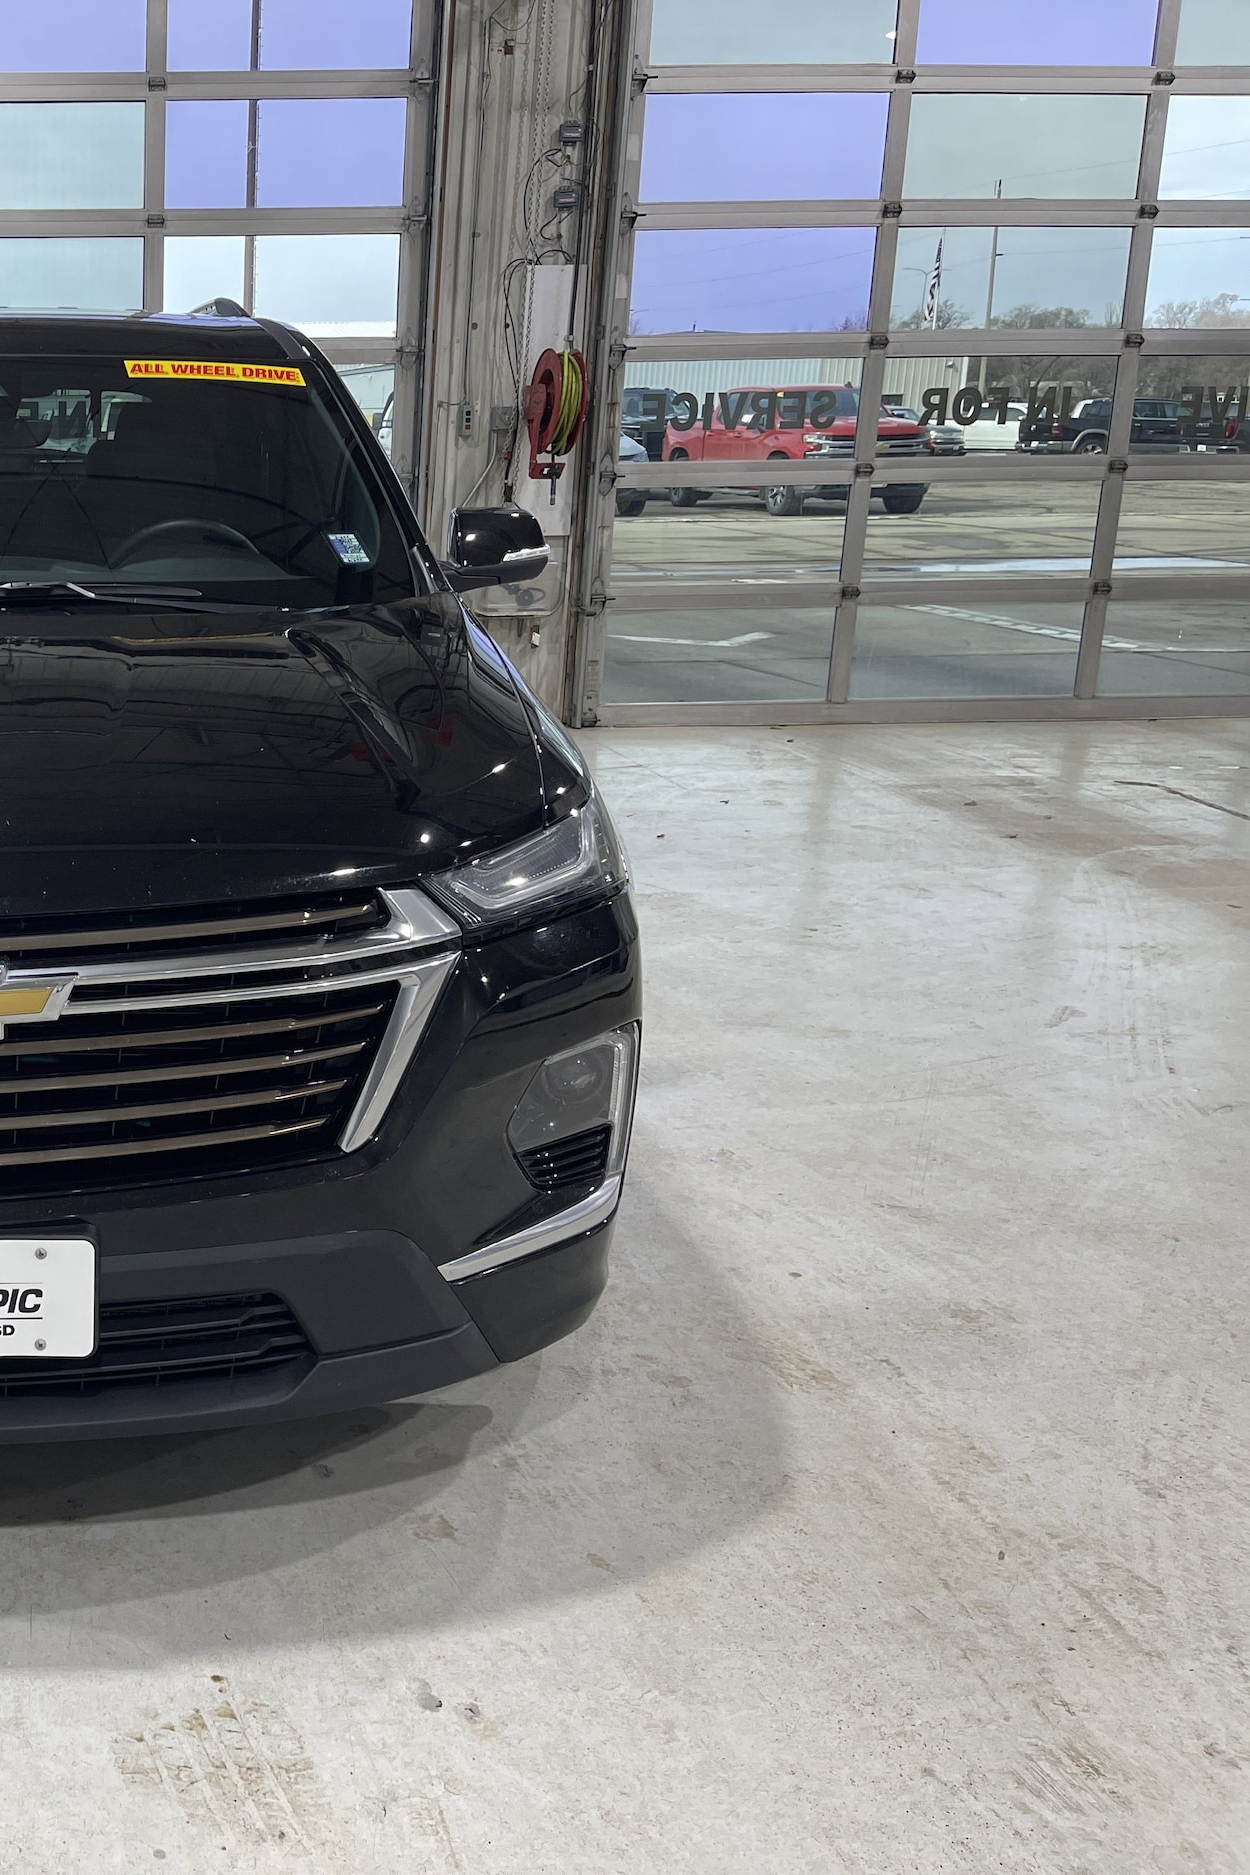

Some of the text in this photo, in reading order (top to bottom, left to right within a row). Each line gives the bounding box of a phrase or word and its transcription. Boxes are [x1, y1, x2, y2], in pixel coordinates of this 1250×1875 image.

[129, 363, 299, 382] ALL WHEEL DRIVE
